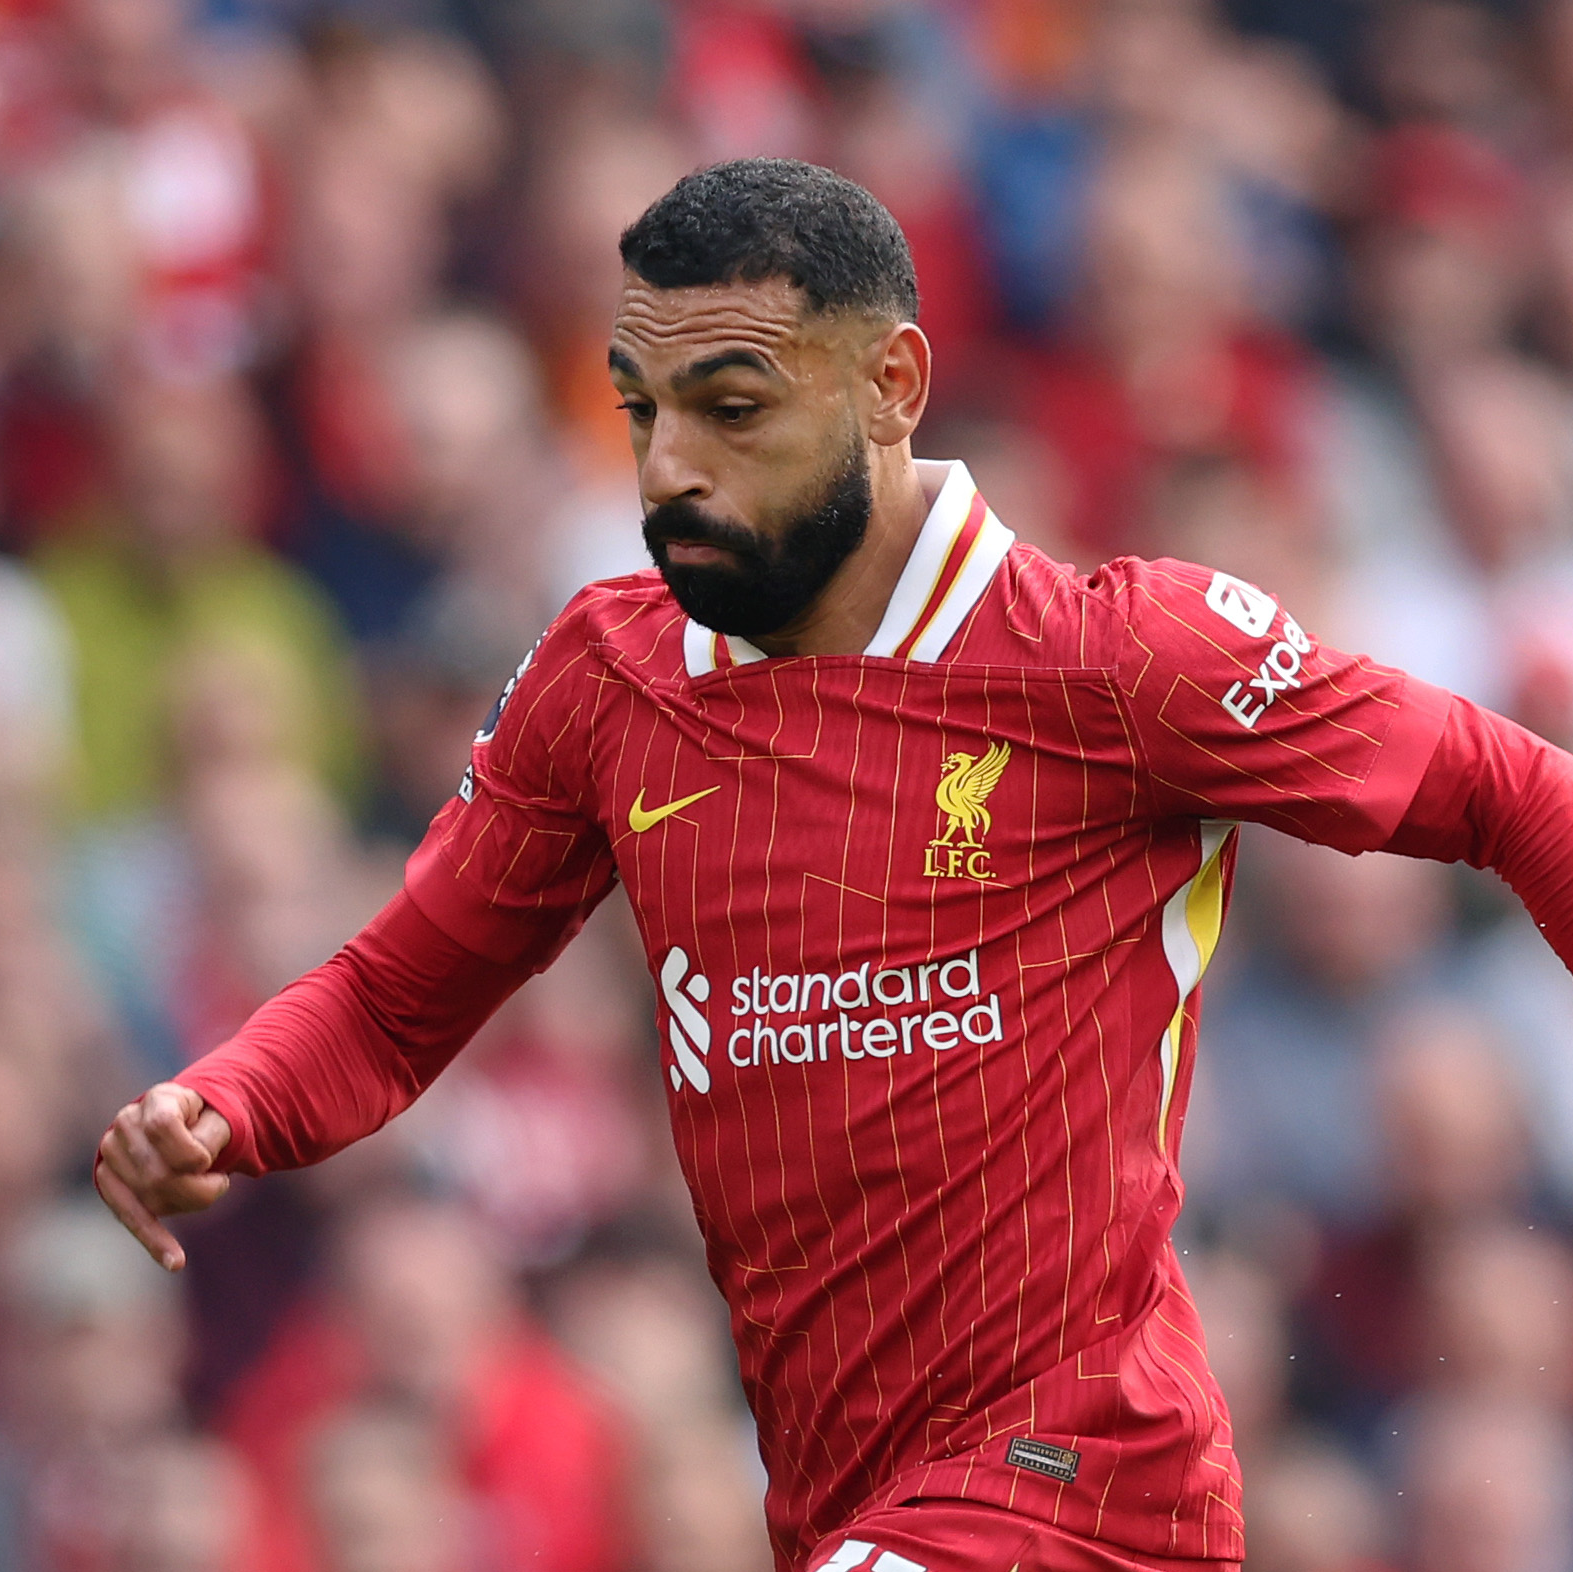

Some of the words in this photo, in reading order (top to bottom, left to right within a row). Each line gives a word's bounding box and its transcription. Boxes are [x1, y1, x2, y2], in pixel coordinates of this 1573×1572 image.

[1221, 611, 1311, 729] Expe
[923, 848, 997, 879] L.F.C.
[731, 947, 981, 1016] standard
[728, 993, 1003, 1067] chartered
